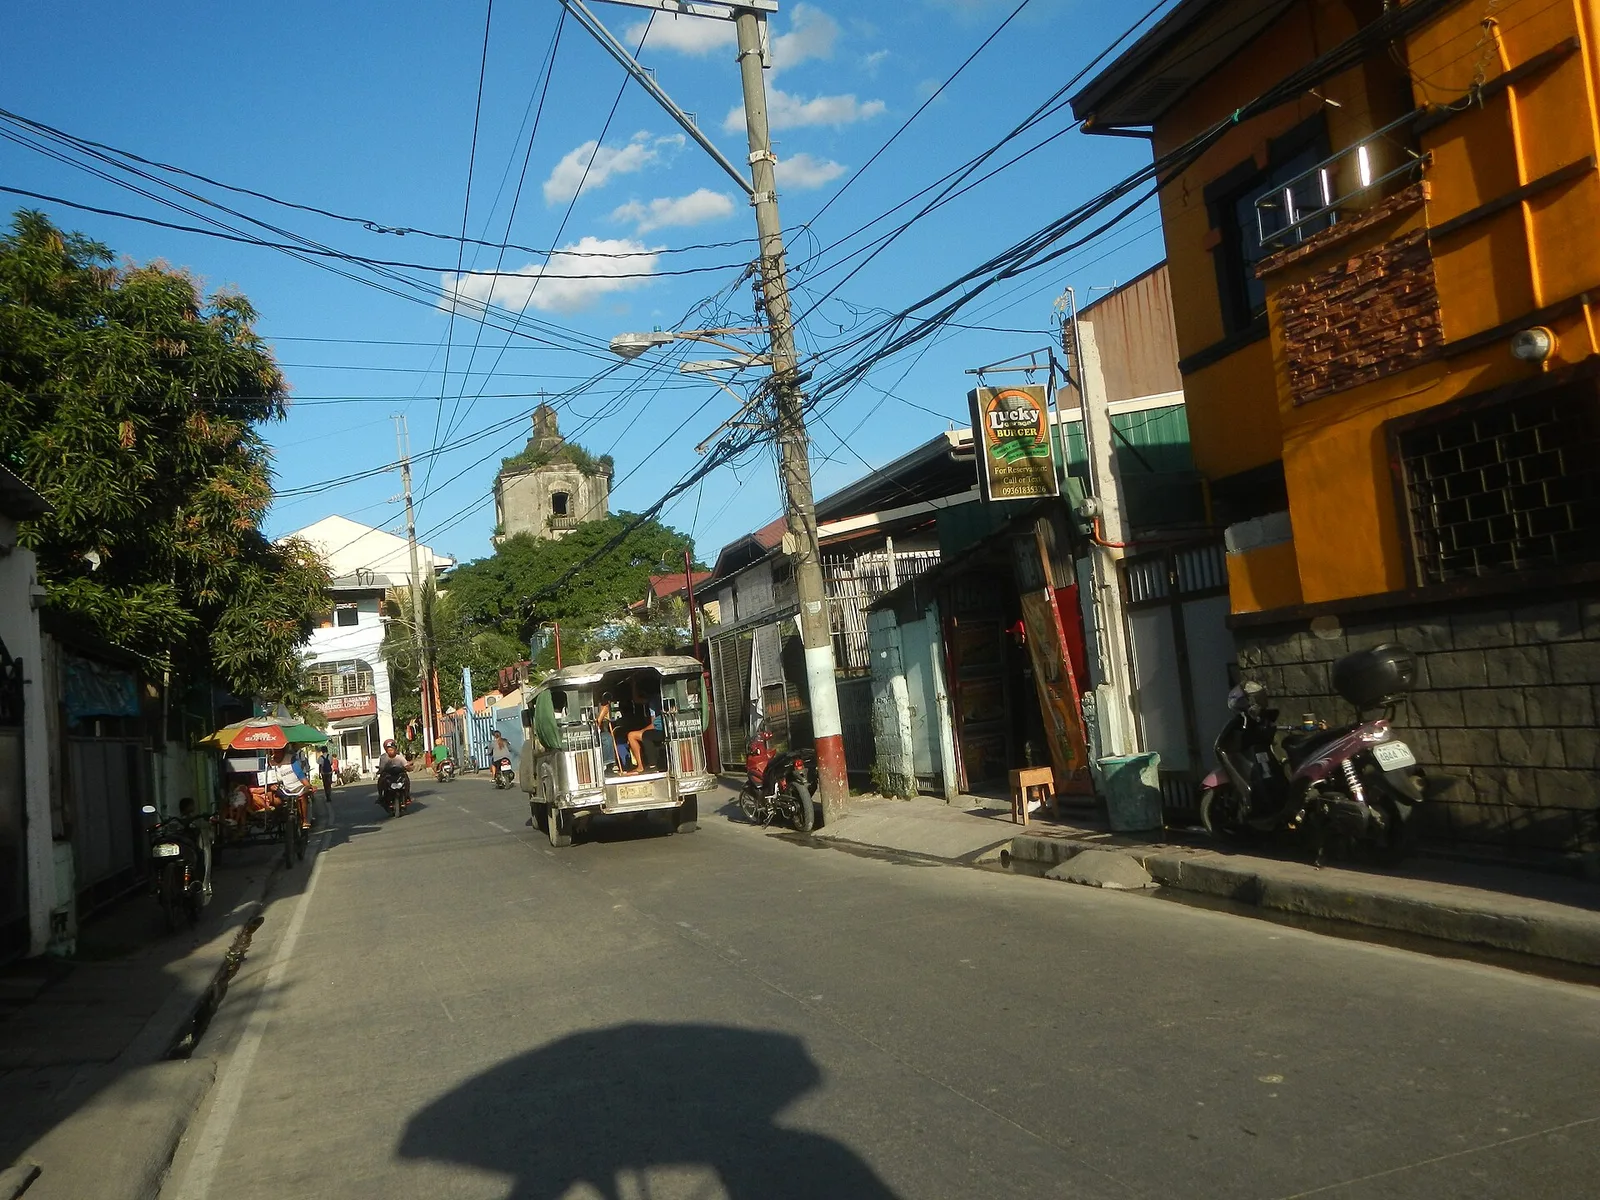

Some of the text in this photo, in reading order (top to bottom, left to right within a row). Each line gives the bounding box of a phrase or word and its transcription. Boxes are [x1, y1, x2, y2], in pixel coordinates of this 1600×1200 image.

[989, 407, 1040, 429] Lucky
[997, 428, 1038, 438] BURGER
[994, 466, 1007, 475] For
[1003, 476, 1017, 485] Call
[1026, 475, 1041, 483] Text
